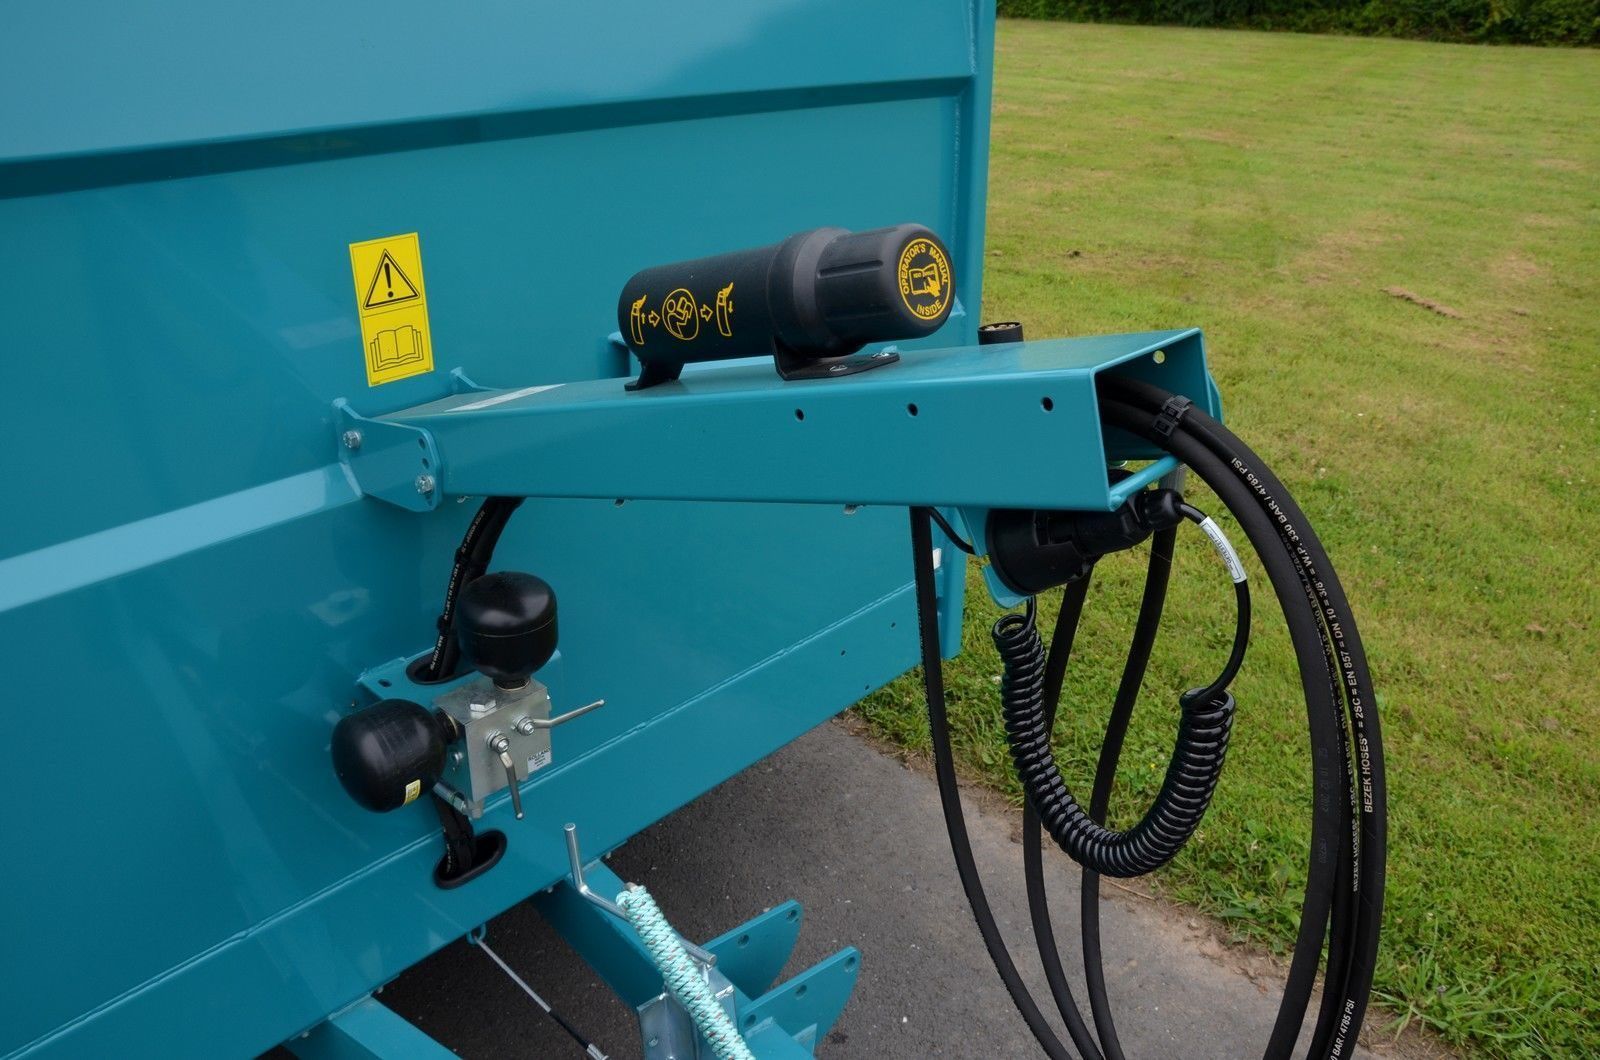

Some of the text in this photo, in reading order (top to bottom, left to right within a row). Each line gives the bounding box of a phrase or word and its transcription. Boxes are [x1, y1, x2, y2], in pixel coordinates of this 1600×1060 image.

[901, 243, 948, 295] OPERATOR'S MANUAL
[916, 299, 942, 316] INSIDE
[1231, 457, 1248, 475] PSI
[1246, 473, 1267, 495] 4785
[1268, 500, 1287, 524] BAR
[1284, 524, 1299, 542] 330
[1297, 542, 1313, 567] W.P.
[1326, 608, 1337, 621] 10
[1332, 622, 1344, 639] DN
[1341, 651, 1353, 669] 857
[1347, 670, 1357, 686] EN
[1352, 697, 1364, 719] 2SC
[1360, 778, 1373, 813] BEZEK
[1344, 999, 1355, 1015] PSI
[1340, 1014, 1352, 1034] 4785
[1332, 1037, 1345, 1056] BAR
